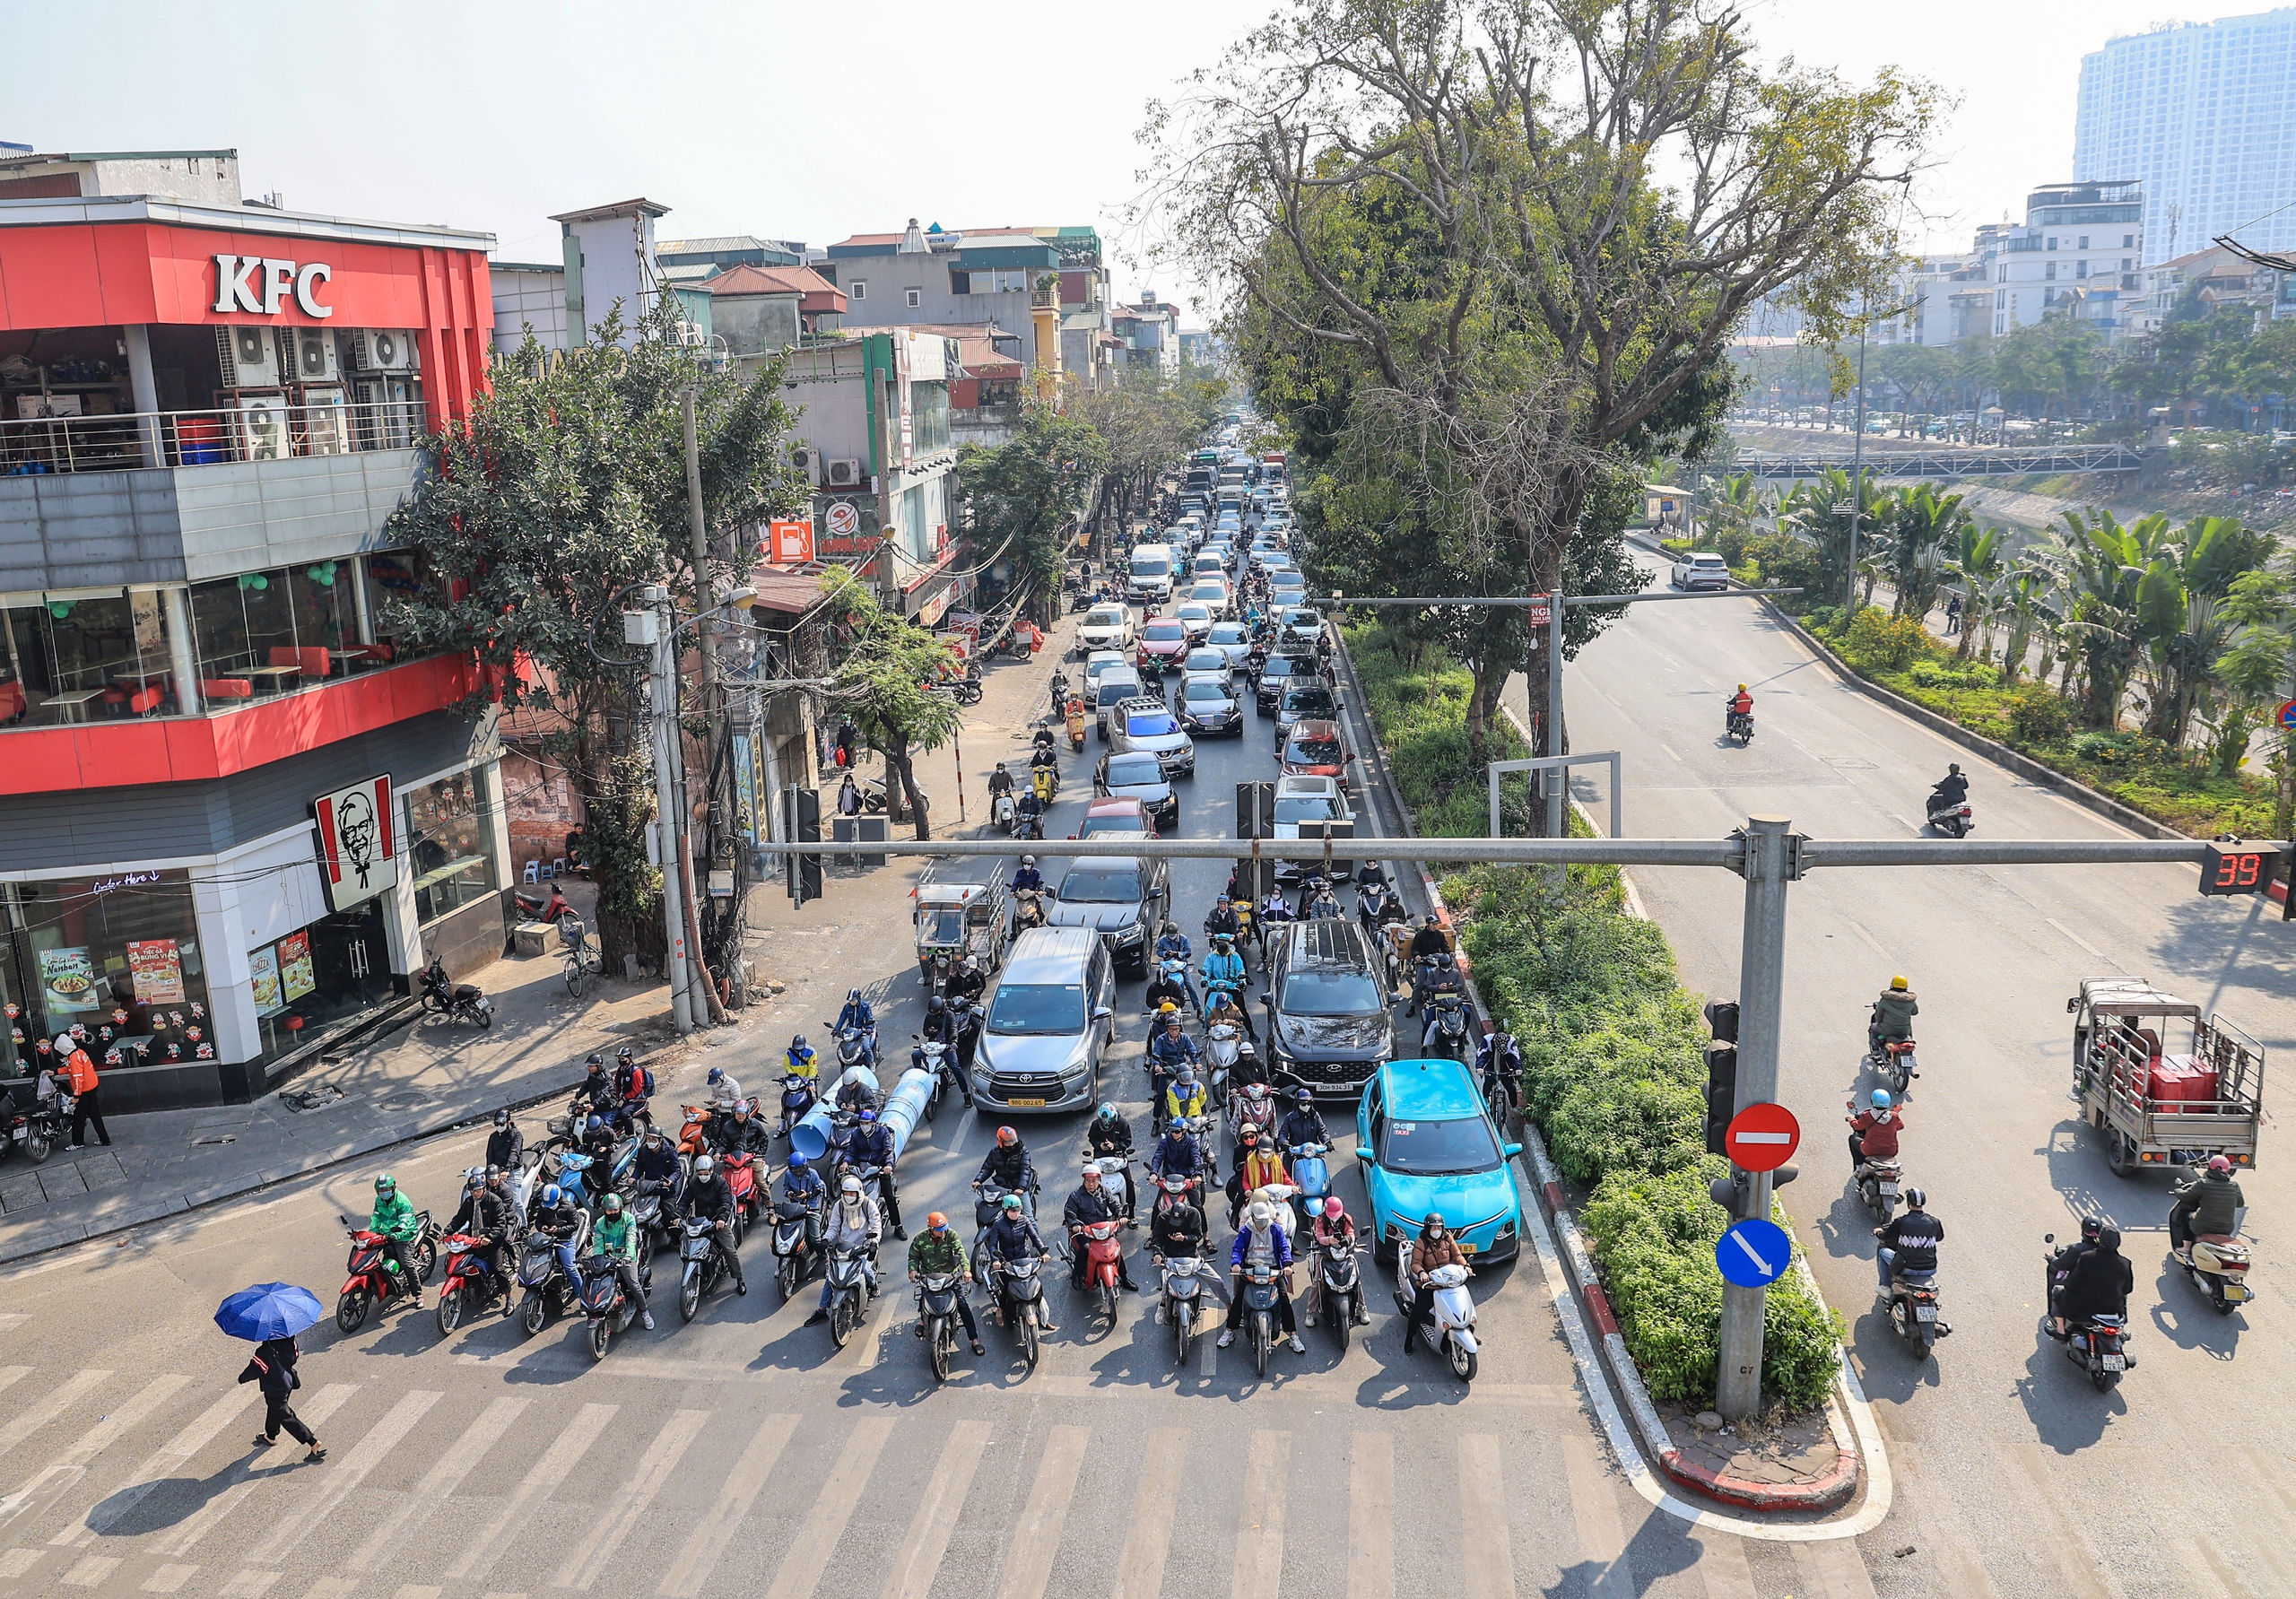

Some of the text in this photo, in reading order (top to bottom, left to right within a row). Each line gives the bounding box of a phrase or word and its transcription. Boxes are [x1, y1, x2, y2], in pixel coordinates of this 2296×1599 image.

[212, 255, 333, 318] KFC
[124, 873, 147, 885] Here
[2215, 854, 2261, 886] 39
[47, 963, 78, 975] Nanban
